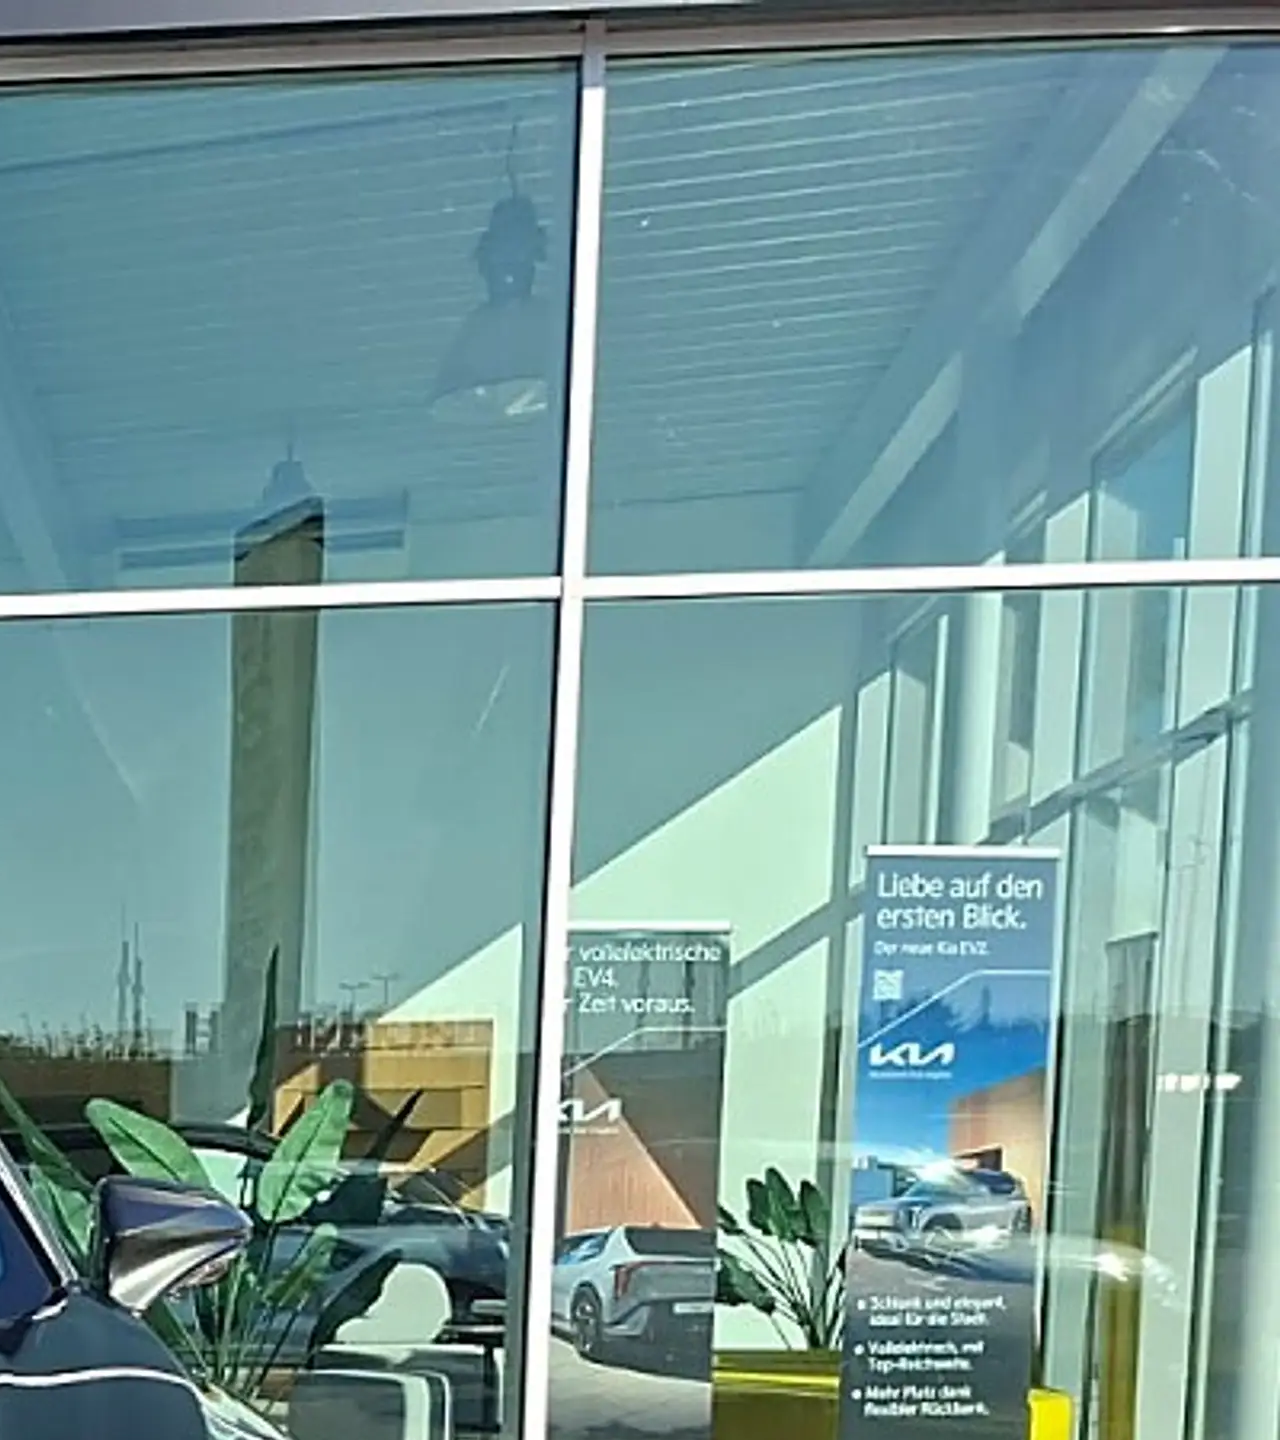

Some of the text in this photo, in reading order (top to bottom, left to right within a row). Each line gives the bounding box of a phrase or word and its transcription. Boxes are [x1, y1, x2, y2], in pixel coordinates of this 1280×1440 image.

[877, 871, 1043, 899] Liebe auf den
[876, 902, 1027, 930] ersten Blick.
[579, 942, 722, 962] vollelektrische
[573, 966, 619, 987] EV4.
[578, 992, 616, 1012] Zeit
[622, 997, 696, 1013] voraus.
[870, 1042, 955, 1067] KIA
